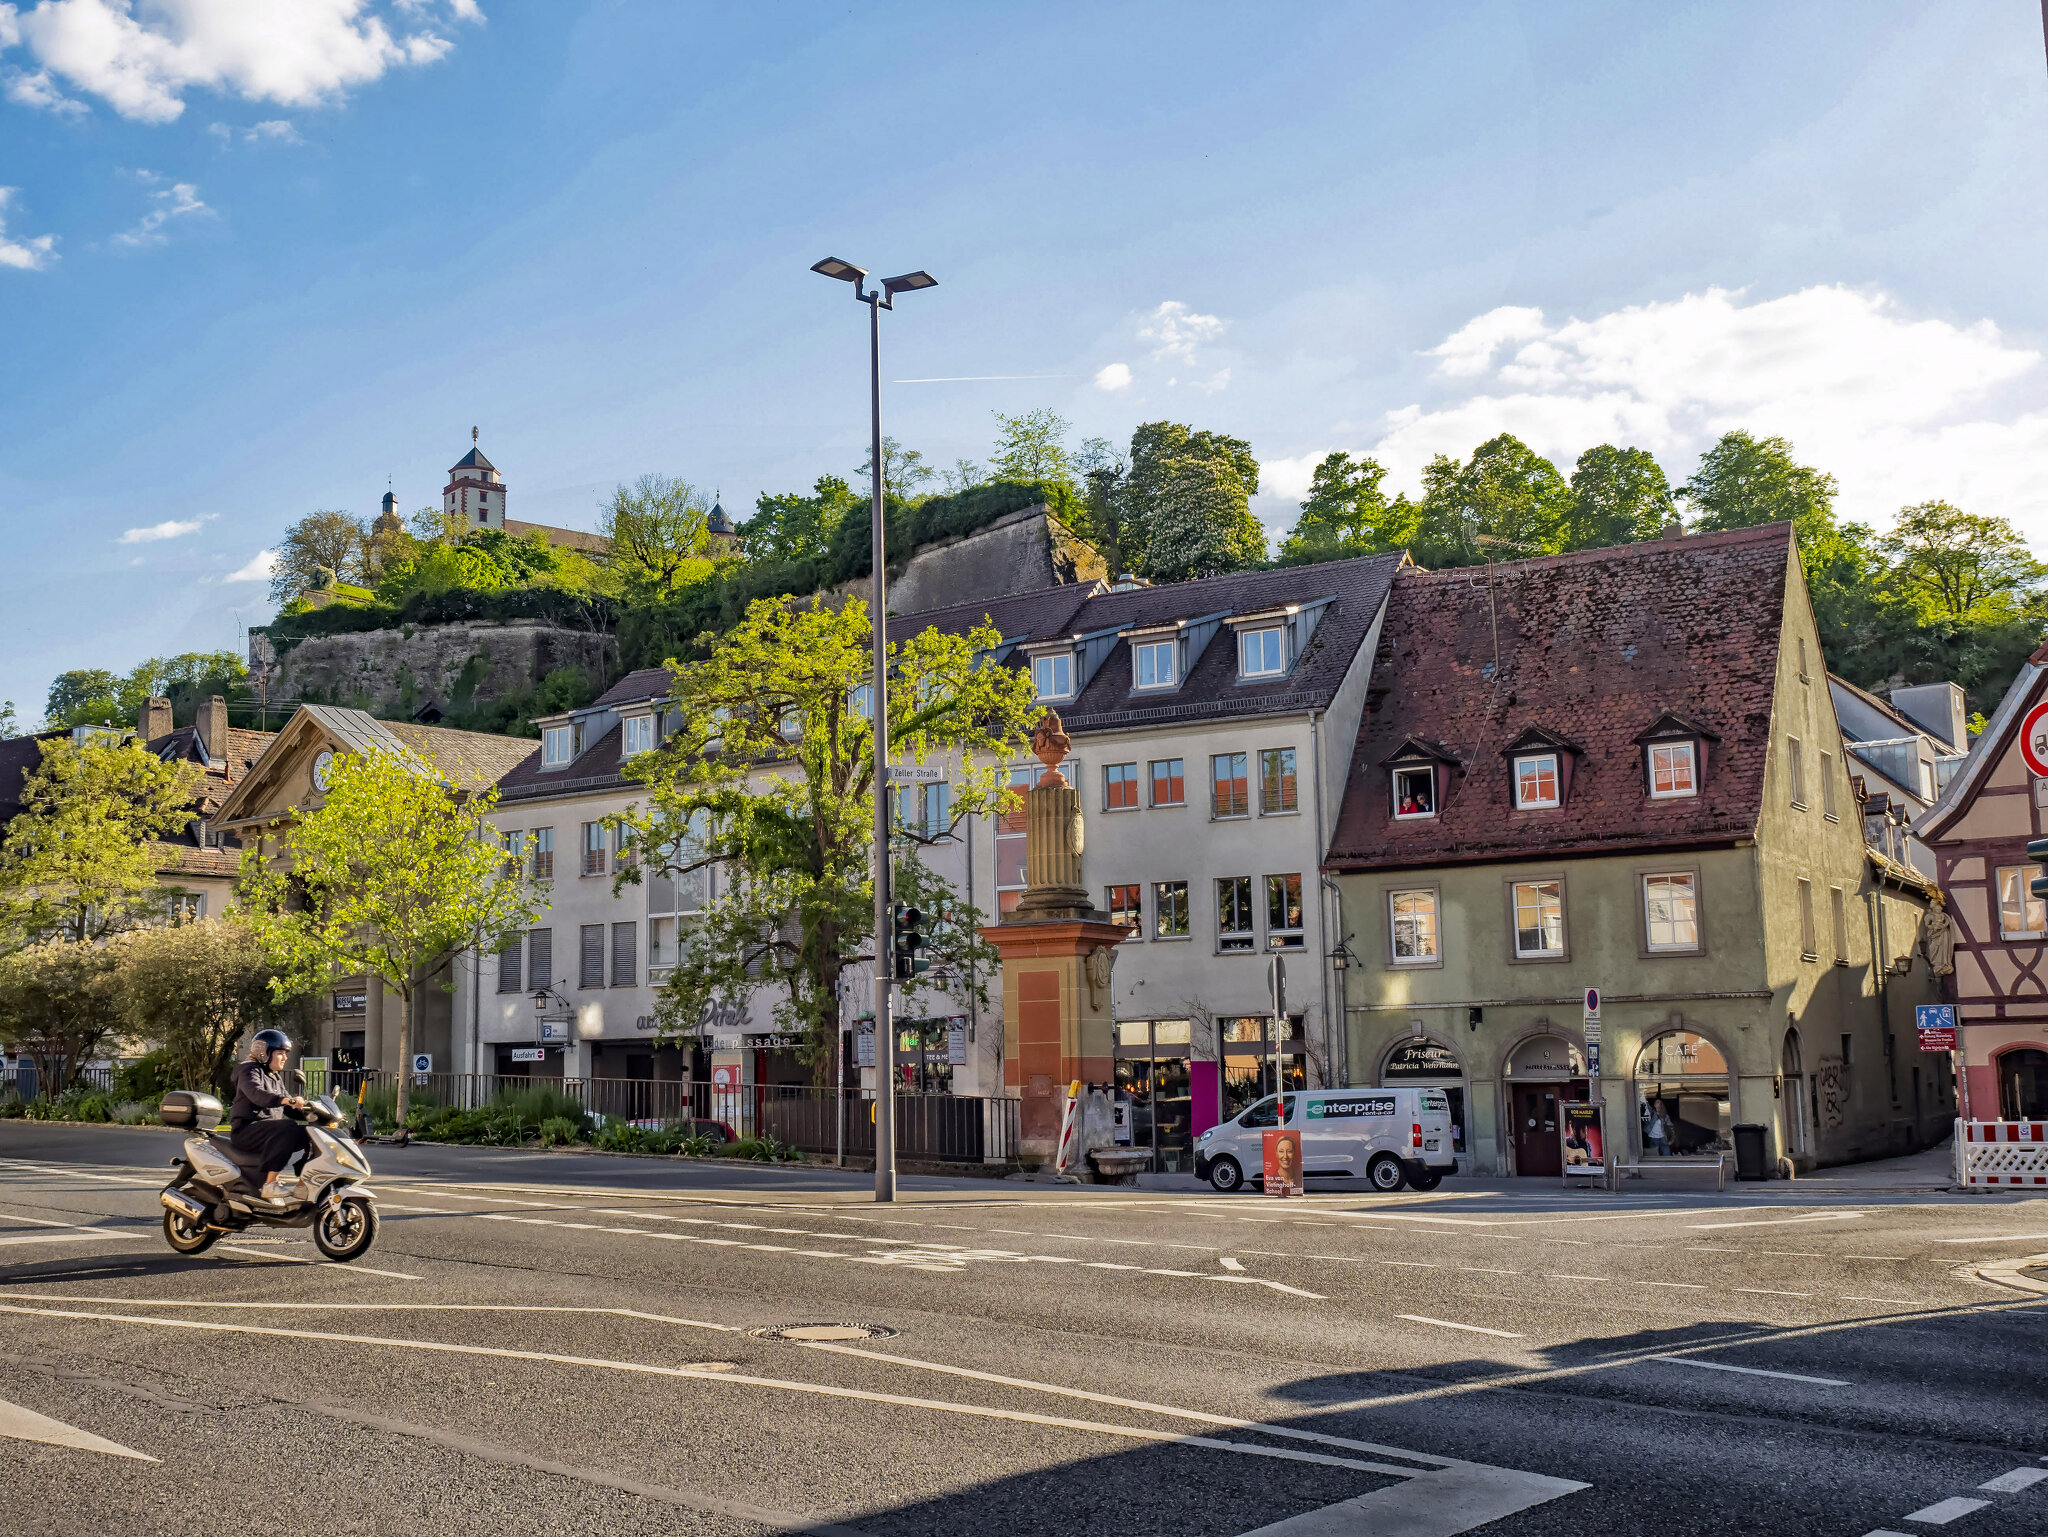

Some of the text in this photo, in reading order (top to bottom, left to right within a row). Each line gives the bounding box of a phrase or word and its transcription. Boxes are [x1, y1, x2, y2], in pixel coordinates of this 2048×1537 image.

[894, 768, 938, 778] Zeller Straße
[1664, 1042, 1698, 1056] CAFÉ
[513, 1051, 536, 1059] Ausfahrt
[1403, 1049, 1441, 1061] Friseur
[1543, 1050, 1550, 1060] 9
[1389, 1062, 1419, 1070] Patricia
[1309, 1100, 1395, 1115] enterprise
